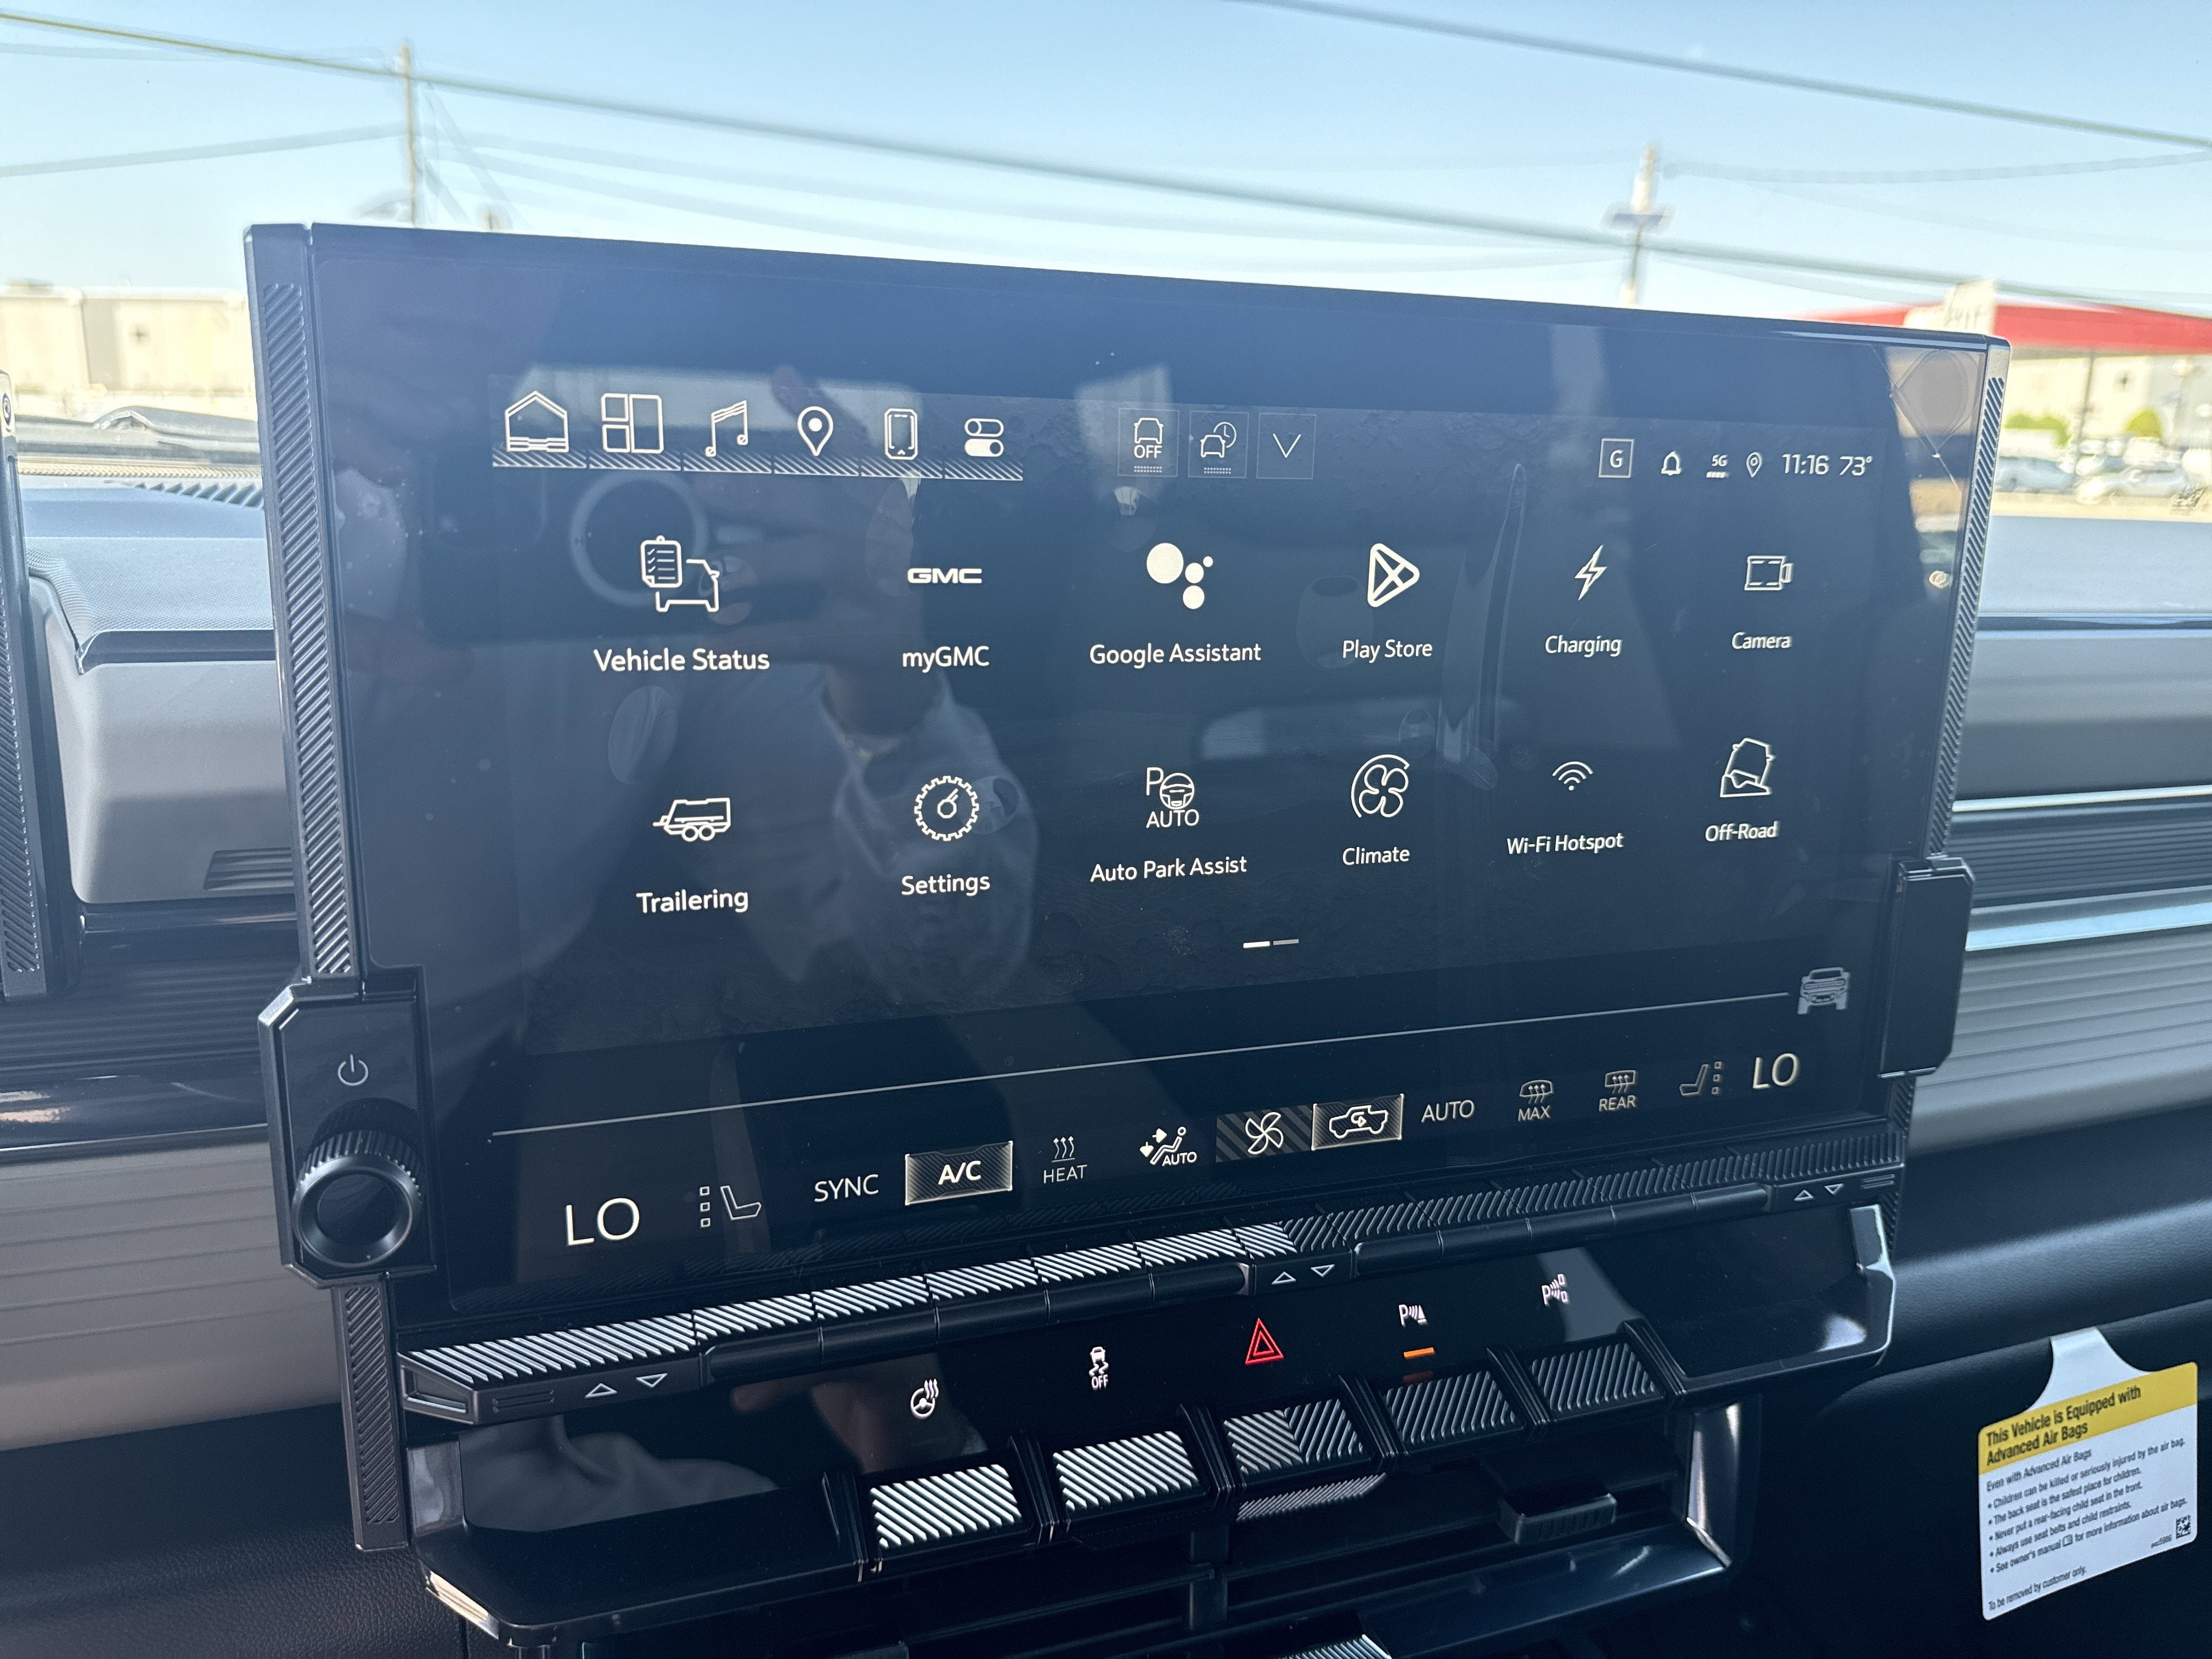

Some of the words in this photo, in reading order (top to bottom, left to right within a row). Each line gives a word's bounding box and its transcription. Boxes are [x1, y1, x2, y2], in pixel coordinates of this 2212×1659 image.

[1133, 444, 1163, 459] OFF
[1610, 450, 1623, 469] G
[1712, 455, 1728, 466] 5G
[1781, 453, 1830, 475] 11:16
[907, 568, 982, 584] GMC
[1342, 639, 1380, 664] Play
[1385, 638, 1433, 658] Store
[1545, 635, 1622, 658] Charging
[1731, 632, 1791, 650] Camera
[594, 647, 686, 673] Vehicle
[692, 647, 769, 671] Status
[902, 645, 990, 673] myGMC
[1090, 642, 1164, 669] Google
[1169, 641, 1261, 663] Assistant
[1146, 767, 1163, 795] P
[1146, 809, 1199, 828] AUTO
[1506, 836, 1551, 854] Wi-Fi
[1555, 832, 1623, 853] Hotspot
[1705, 821, 1778, 842] Off-Road
[1342, 846, 1410, 865] Climate
[1090, 864, 1137, 882] Auto
[1144, 858, 1185, 878] Park
[1190, 855, 1247, 875] Assist
[901, 873, 991, 896] Settings
[636, 888, 748, 913] Trailering
[1753, 1053, 1799, 1090] LO
[1421, 1100, 1475, 1123] AUTO
[1518, 1105, 1550, 1121] MAX
[1599, 1095, 1637, 1112] REAR
[1163, 1152, 1197, 1166] AUTO
[938, 1160, 981, 1185] A/C
[1043, 1164, 1087, 1184] HEAT
[814, 1173, 878, 1203] SYNC
[565, 1197, 640, 1246] LO
[1542, 1285, 1551, 1306] P
[1399, 1305, 1408, 1327] P
[1091, 1372, 1108, 1389] OFF
[1987, 1428, 2008, 1446] This
[2011, 1414, 2051, 1437] Vehicle
[2053, 1409, 2063, 1424] is
[2066, 1392, 2115, 1421] Equipped
[2118, 1385, 2141, 1403] with
[1987, 1434, 2040, 1466] Advanced
[2043, 1430, 2058, 1446] Air
[2061, 1423, 2088, 1441] Bags
[1987, 1479, 2004, 1492] Even
[2006, 1470, 2022, 1484] with
[2023, 1457, 2059, 1478] Advanced
[2061, 1454, 2072, 1465] Air
[2073, 1449, 2091, 1462] Bags
[1994, 1491, 2023, 1508] Children
[2024, 1486, 2037, 1497] can
[2039, 1482, 2047, 1492] be
[2050, 1473, 2069, 1488] killed
[2070, 1472, 2079, 1481] or
[2080, 1461, 2111, 1479] seriously
[2112, 1451, 2136, 1468] injured
[2137, 1450, 2146, 1460] by
[2147, 1446, 2159, 1455] the
[2160, 1441, 2169, 1452] air
[1993, 1513, 2006, 1524] The
[2008, 1505, 2024, 1519] back
[2025, 1499, 2040, 1512] seat
[2041, 1497, 2047, 1506] is
[2049, 1494, 2059, 1504] the
[2062, 1485, 2082, 1500] safest
[2084, 1481, 2101, 1494] place
[2103, 1476, 2112, 1485] for
[1995, 1526, 2014, 1540] Never
[2016, 1520, 2027, 1534] put
[2028, 1520, 2033, 1528] a
[2034, 1506, 2071, 1525] rear-facing
[2072, 1498, 2089, 1512] child
[2090, 1493, 2104, 1506] seat
[2106, 1492, 2112, 1500] in
[2113, 1488, 2124, 1497] the
[1996, 1541, 2019, 1556] Always
[2021, 1536, 2032, 1547] use
[2034, 1528, 2049, 1542] seat
[2050, 1523, 2066, 1536] belts
[2068, 1517, 2080, 1529] and
[2081, 1511, 2098, 1524] child
[1996, 1561, 2008, 1572] See
[2038, 1539, 2061, 1556] manual
[2075, 1532, 2084, 1542] for
[2085, 1527, 2102, 1538] more
[2103, 1513, 2140, 1532] information
[2141, 1505, 2159, 1519] about
[1988, 1601, 1996, 1610] To
[1997, 1598, 2005, 1607] be
[2006, 1583, 2033, 1603] removed
[2033, 1583, 2041, 1593] by
[2042, 1571, 2071, 1588] customer
